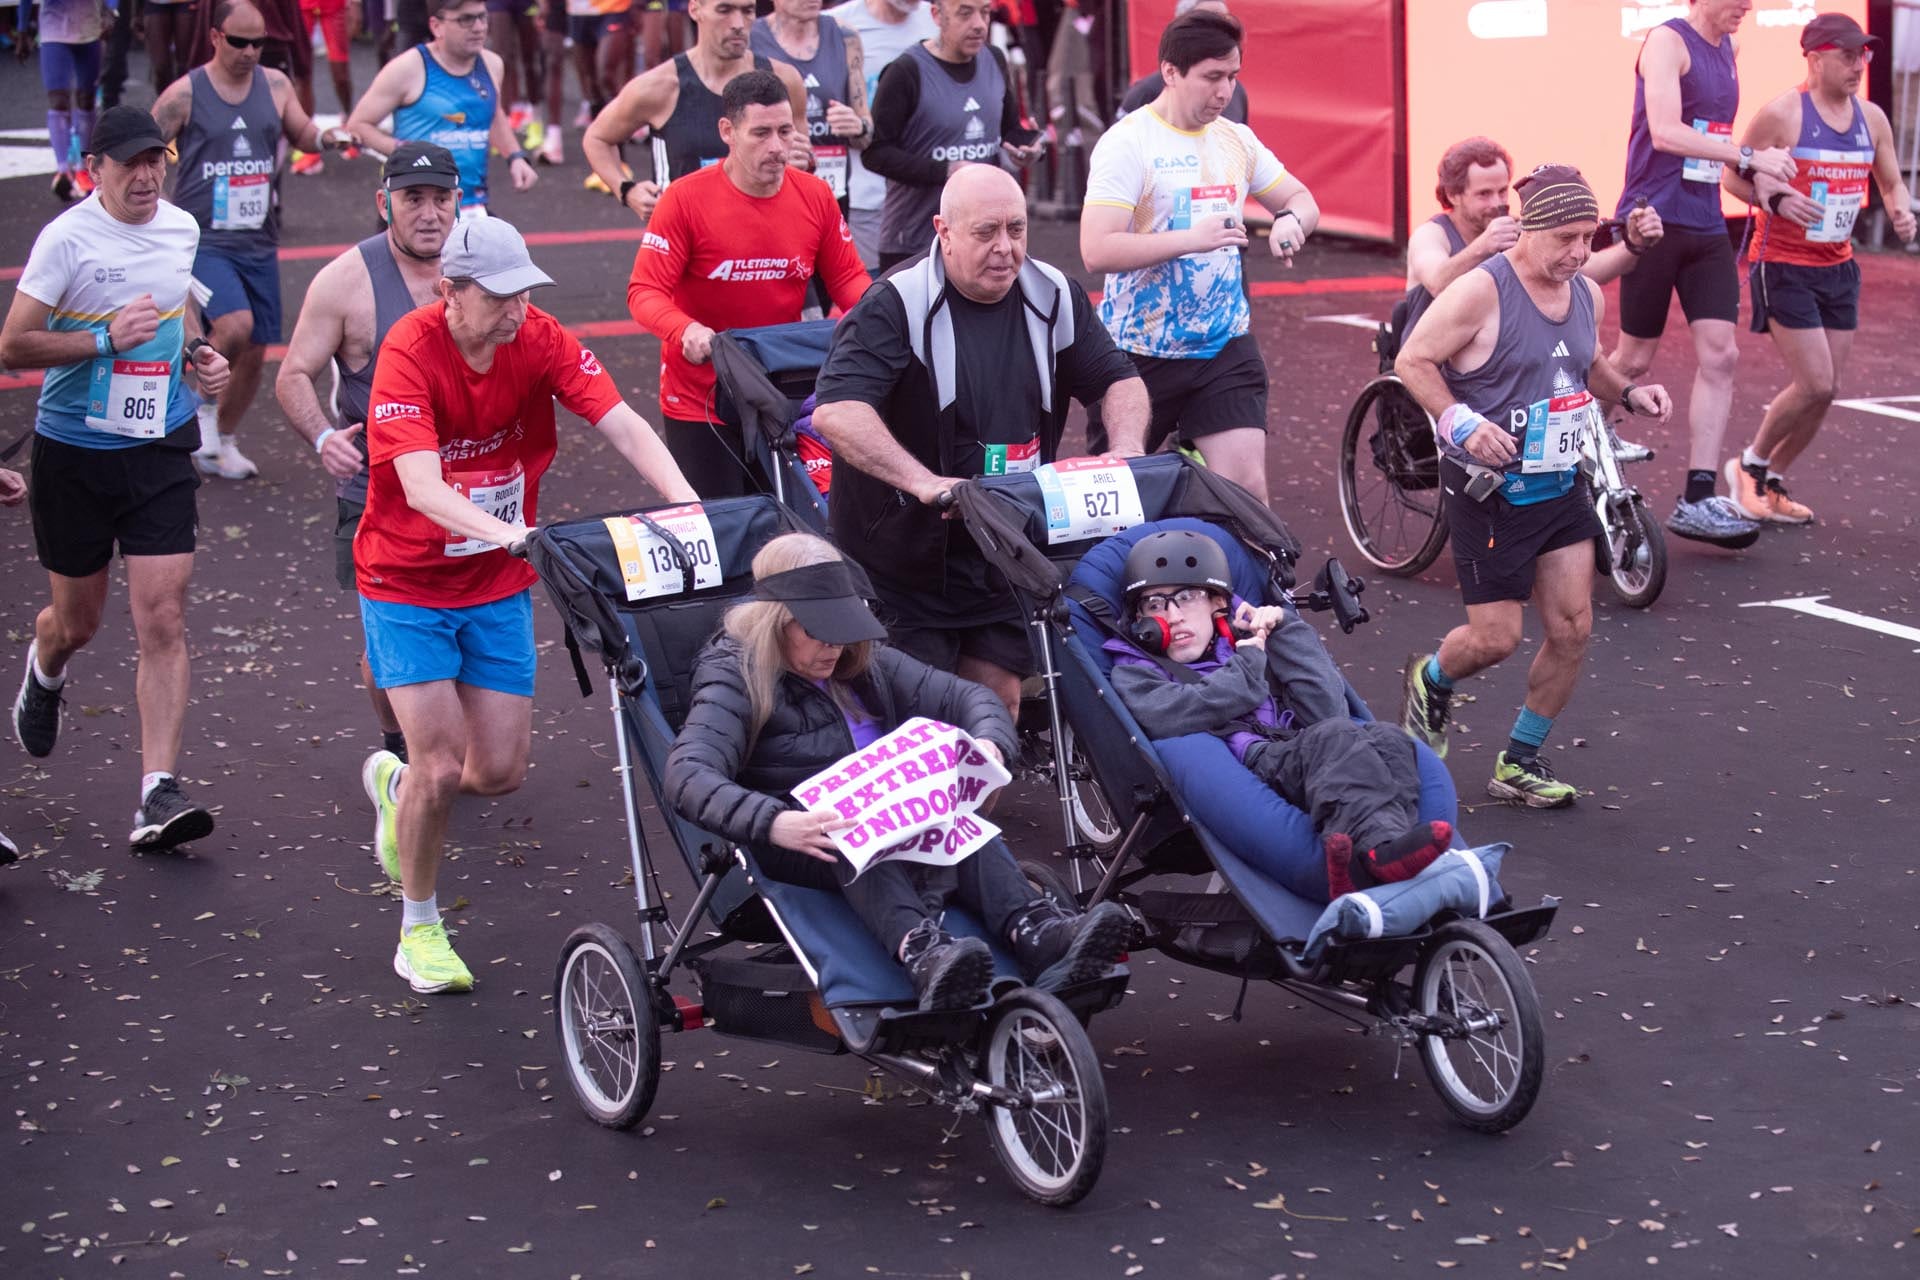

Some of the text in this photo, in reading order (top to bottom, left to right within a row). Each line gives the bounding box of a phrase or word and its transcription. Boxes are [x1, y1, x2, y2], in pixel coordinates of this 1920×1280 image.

[239, 200, 263, 217] 533
[1179, 195, 1187, 210] P
[97, 366, 106, 381] P
[123, 397, 156, 420] 805
[1535, 407, 1543, 423] P
[991, 454, 1001, 472] E
[1093, 473, 1117, 485] ARIEL
[494, 482, 521, 502] RODOLFO
[1083, 490, 1120, 519] 527
[842, 783, 958, 849] UNIDOS
